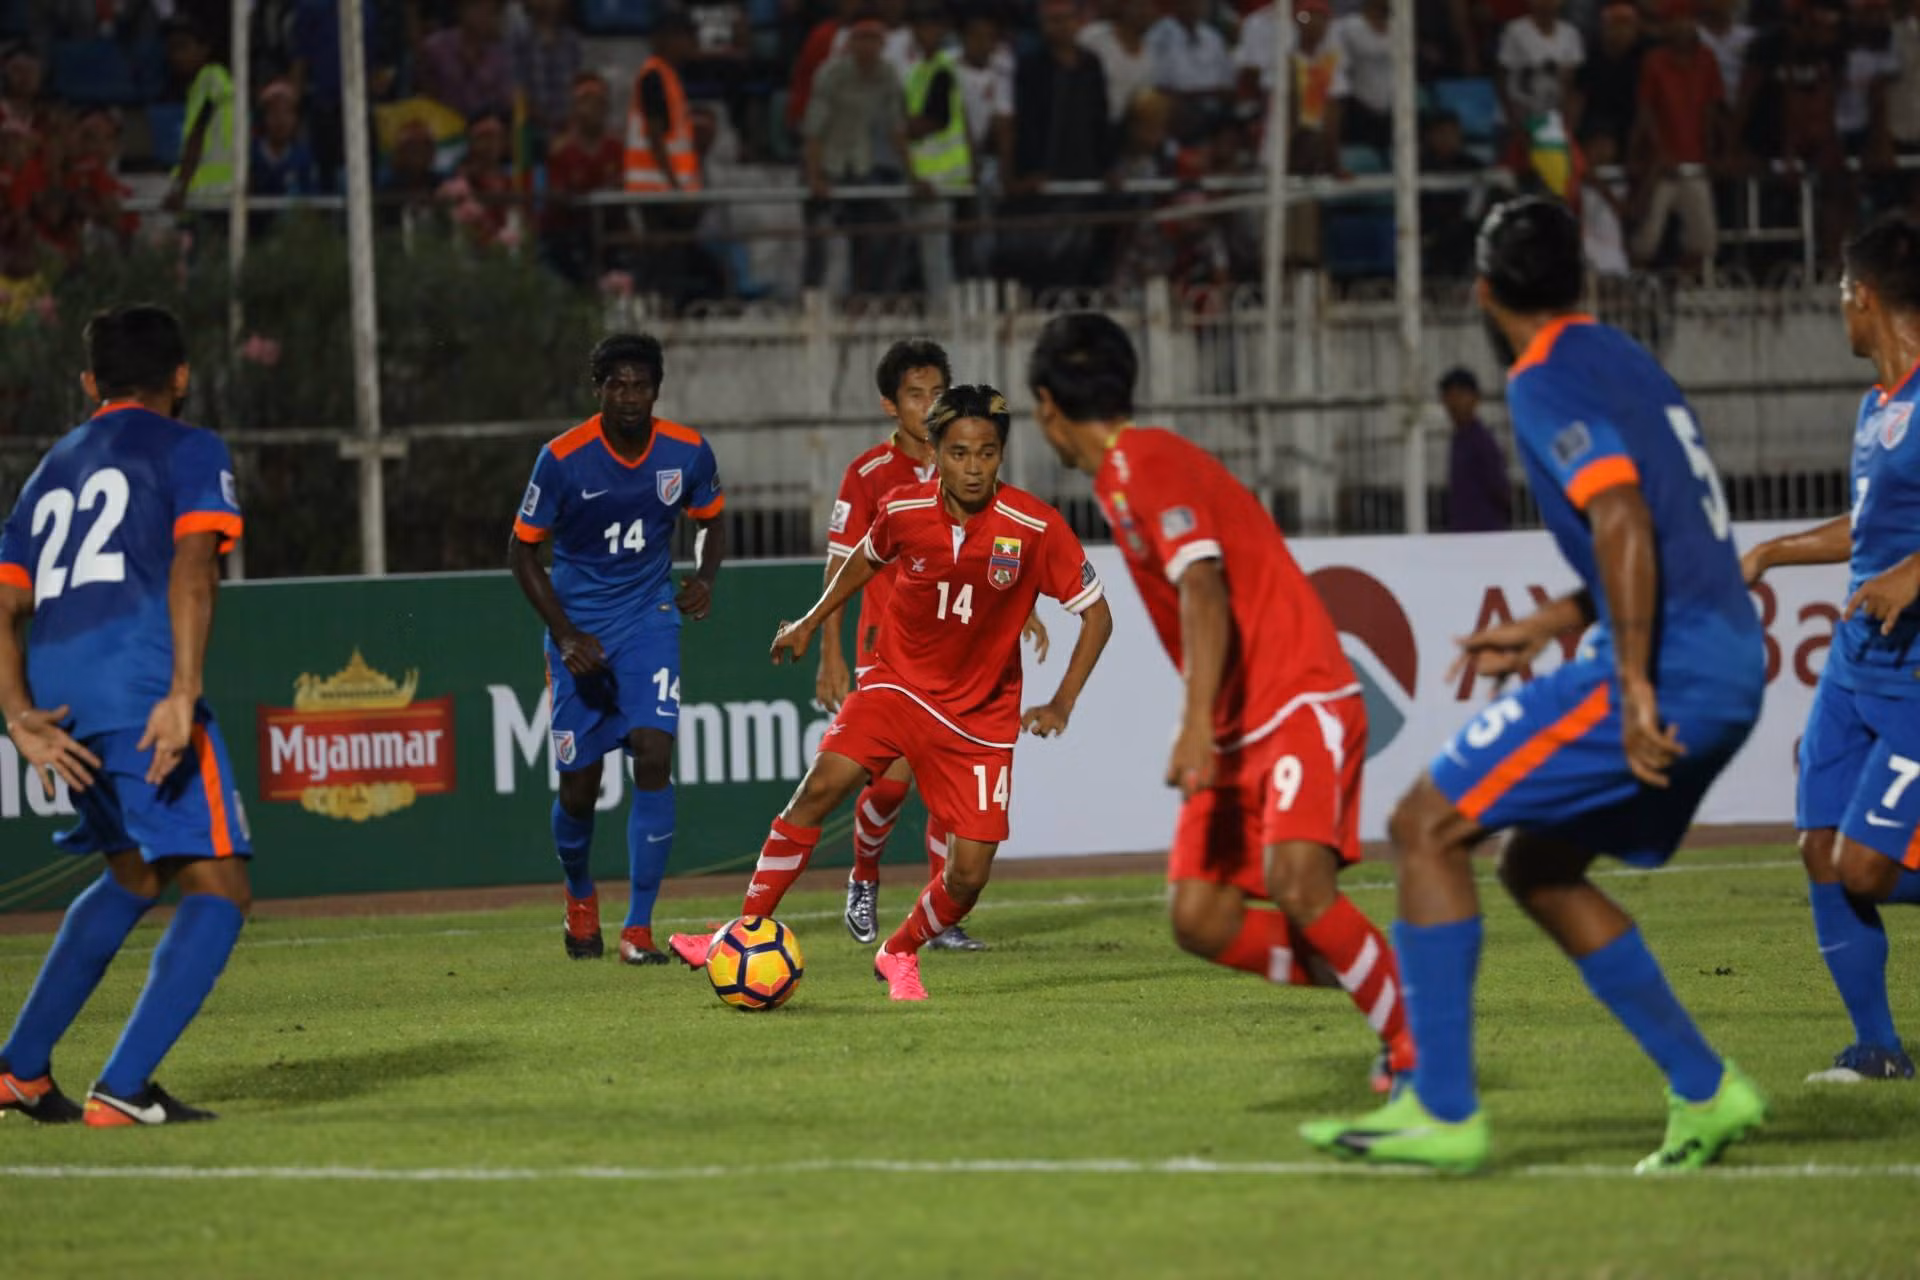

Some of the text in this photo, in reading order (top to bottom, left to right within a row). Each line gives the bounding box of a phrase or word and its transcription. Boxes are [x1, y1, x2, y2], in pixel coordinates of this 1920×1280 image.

[31, 467, 130, 611] 22
[604, 518, 646, 554] 14
[936, 581, 974, 625] 14
[1467, 697, 1523, 748] 5
[269, 724, 444, 781] Myanmar
[972, 764, 1009, 811] 14
[1273, 754, 1304, 812] 9
[1881, 753, 1920, 809] 7
